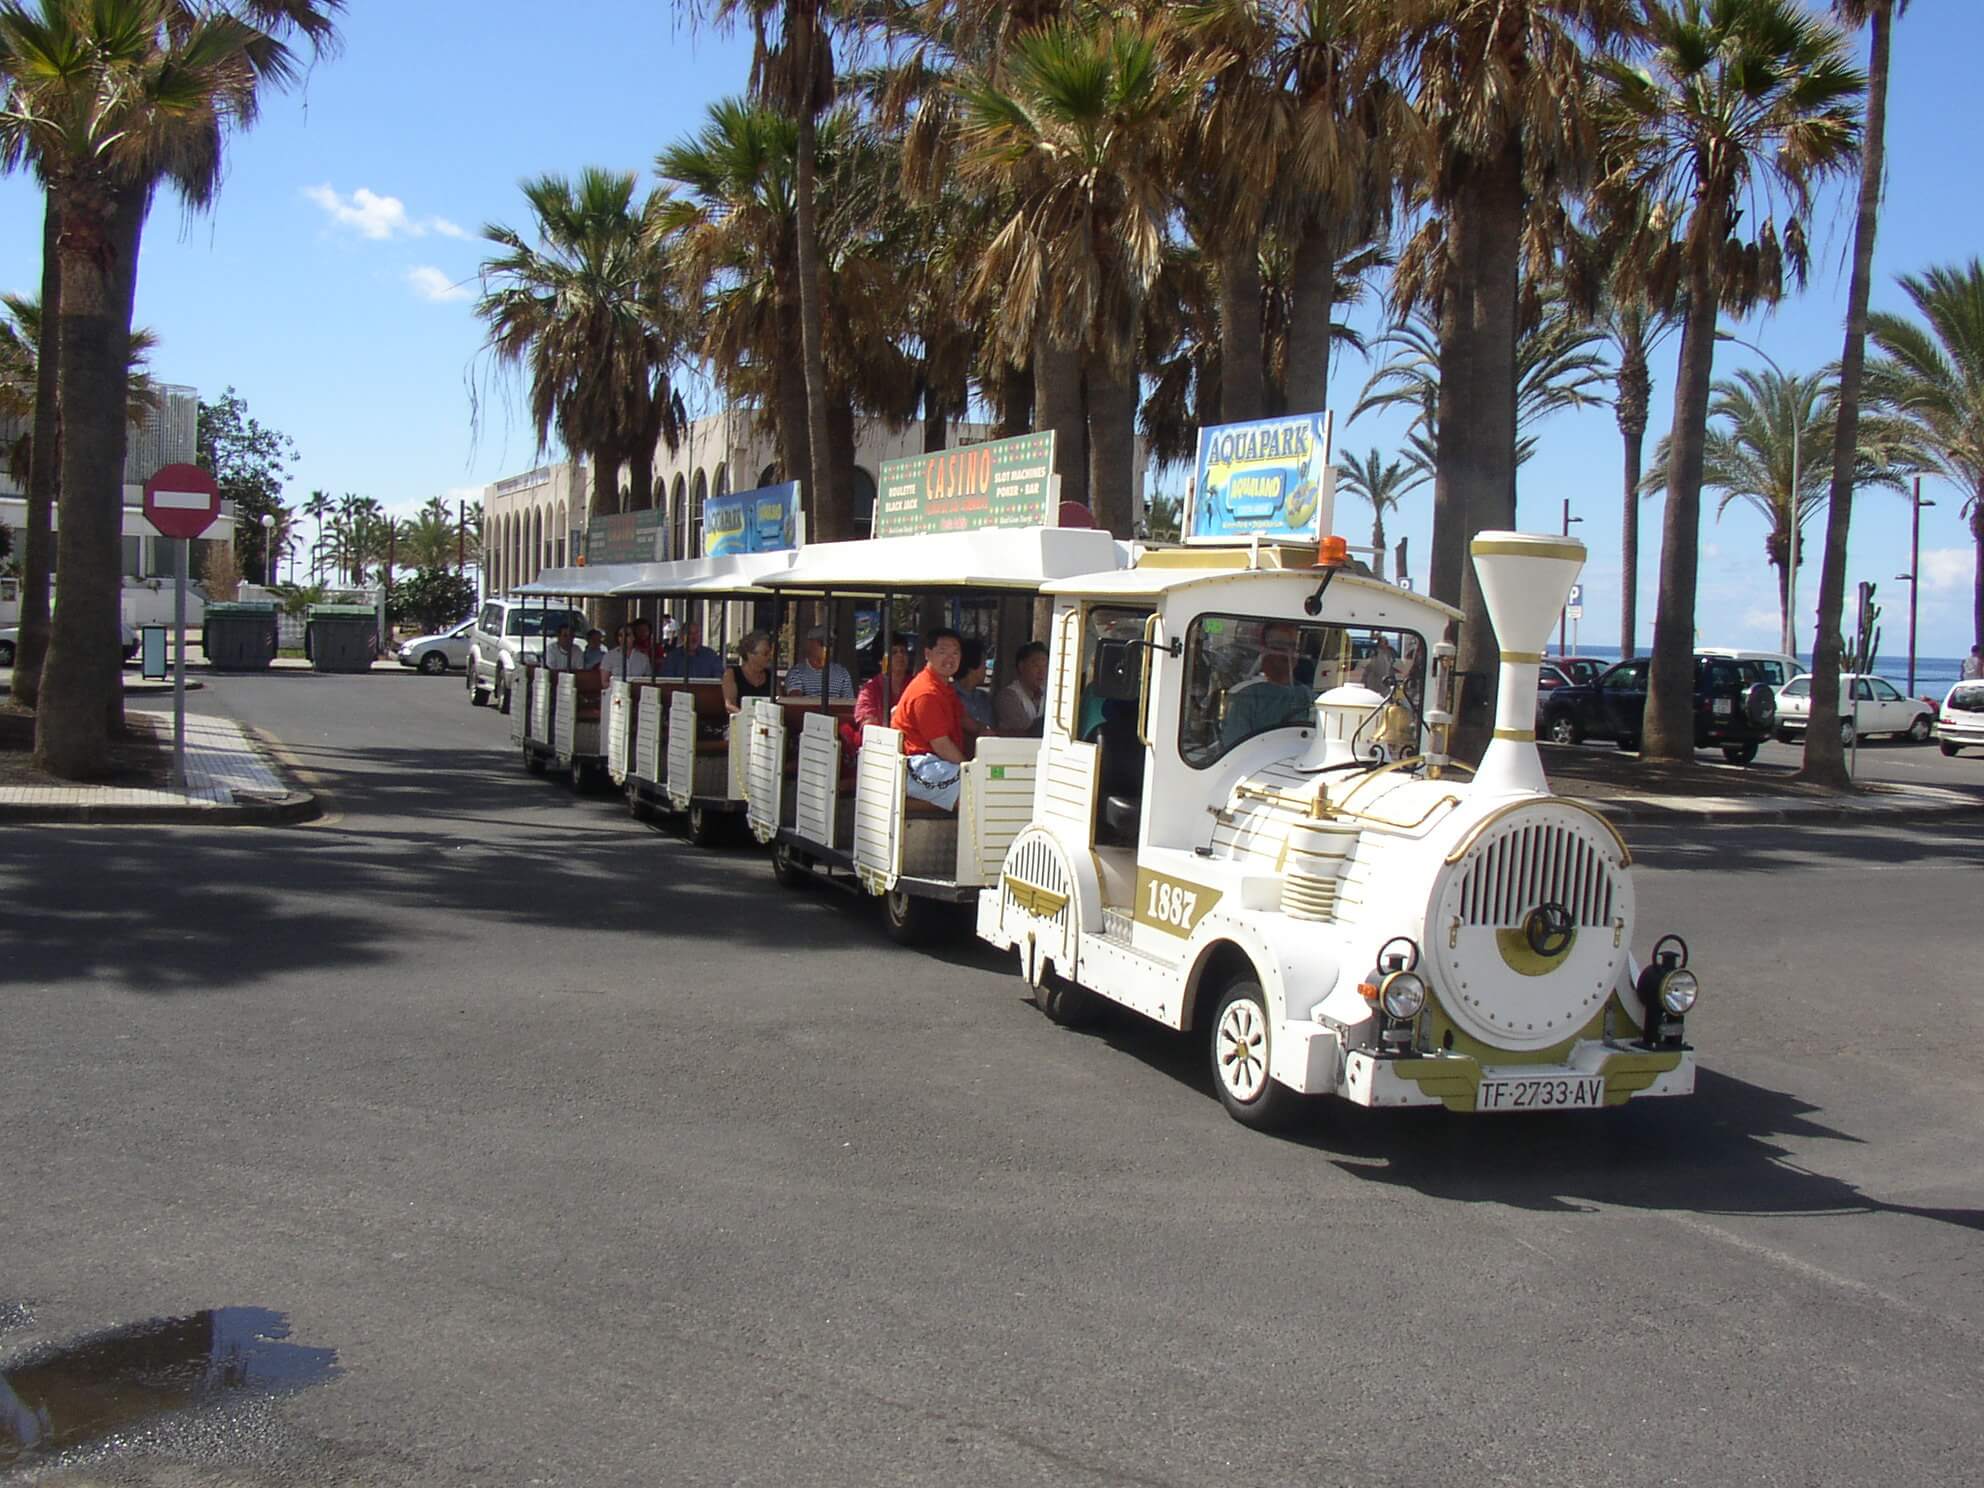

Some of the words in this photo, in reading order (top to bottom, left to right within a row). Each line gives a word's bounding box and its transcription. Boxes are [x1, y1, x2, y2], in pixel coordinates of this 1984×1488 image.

[1207, 423, 1310, 467] AQUAPARK
[926, 448, 991, 500] CASINO
[1011, 465, 1046, 481] MACHINES
[1569, 586, 1580, 605] P
[1147, 879, 1198, 930] 1887
